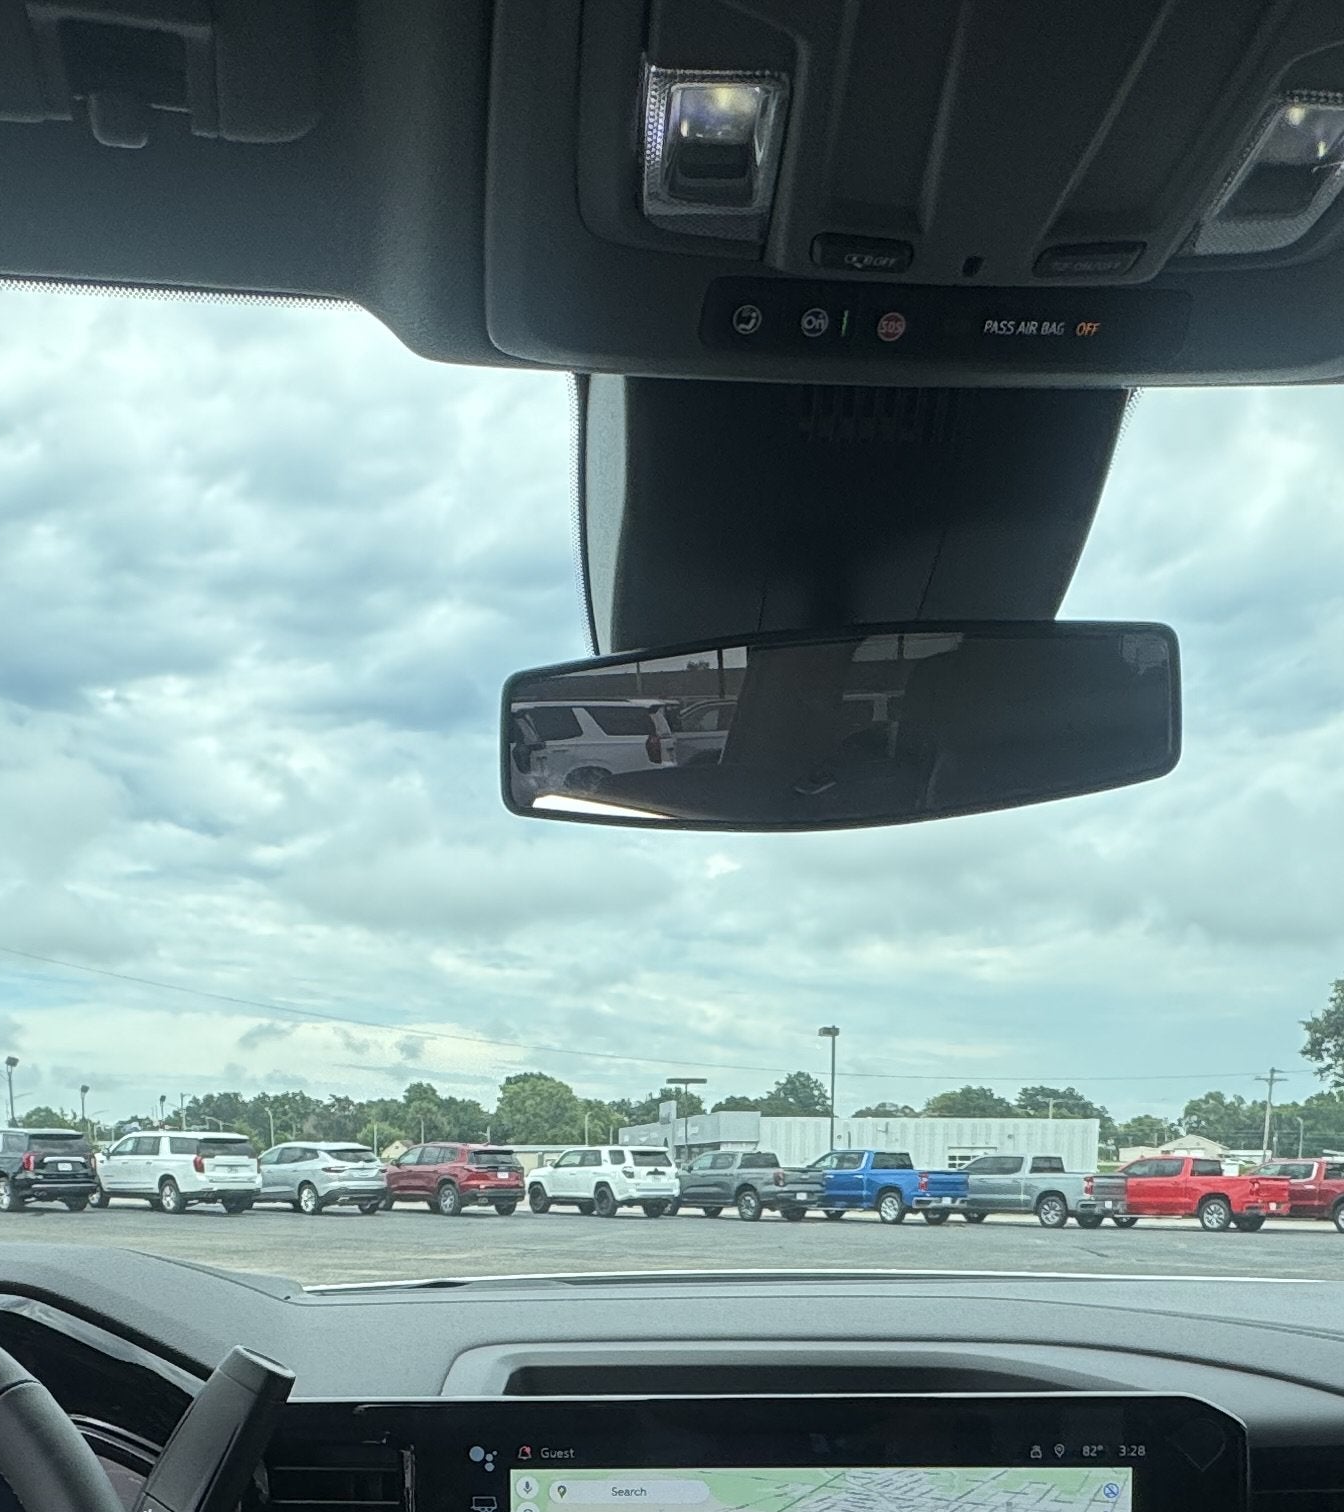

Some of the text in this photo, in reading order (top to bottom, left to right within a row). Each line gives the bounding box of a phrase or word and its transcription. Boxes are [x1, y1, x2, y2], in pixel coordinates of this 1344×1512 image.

[881, 320, 902, 333] SOS
[983, 320, 1101, 336] PASS AIR BAG OFF
[540, 1448, 575, 1459] Guest
[1119, 1445, 1146, 1456] 3:28
[611, 1486, 647, 1498] Search
